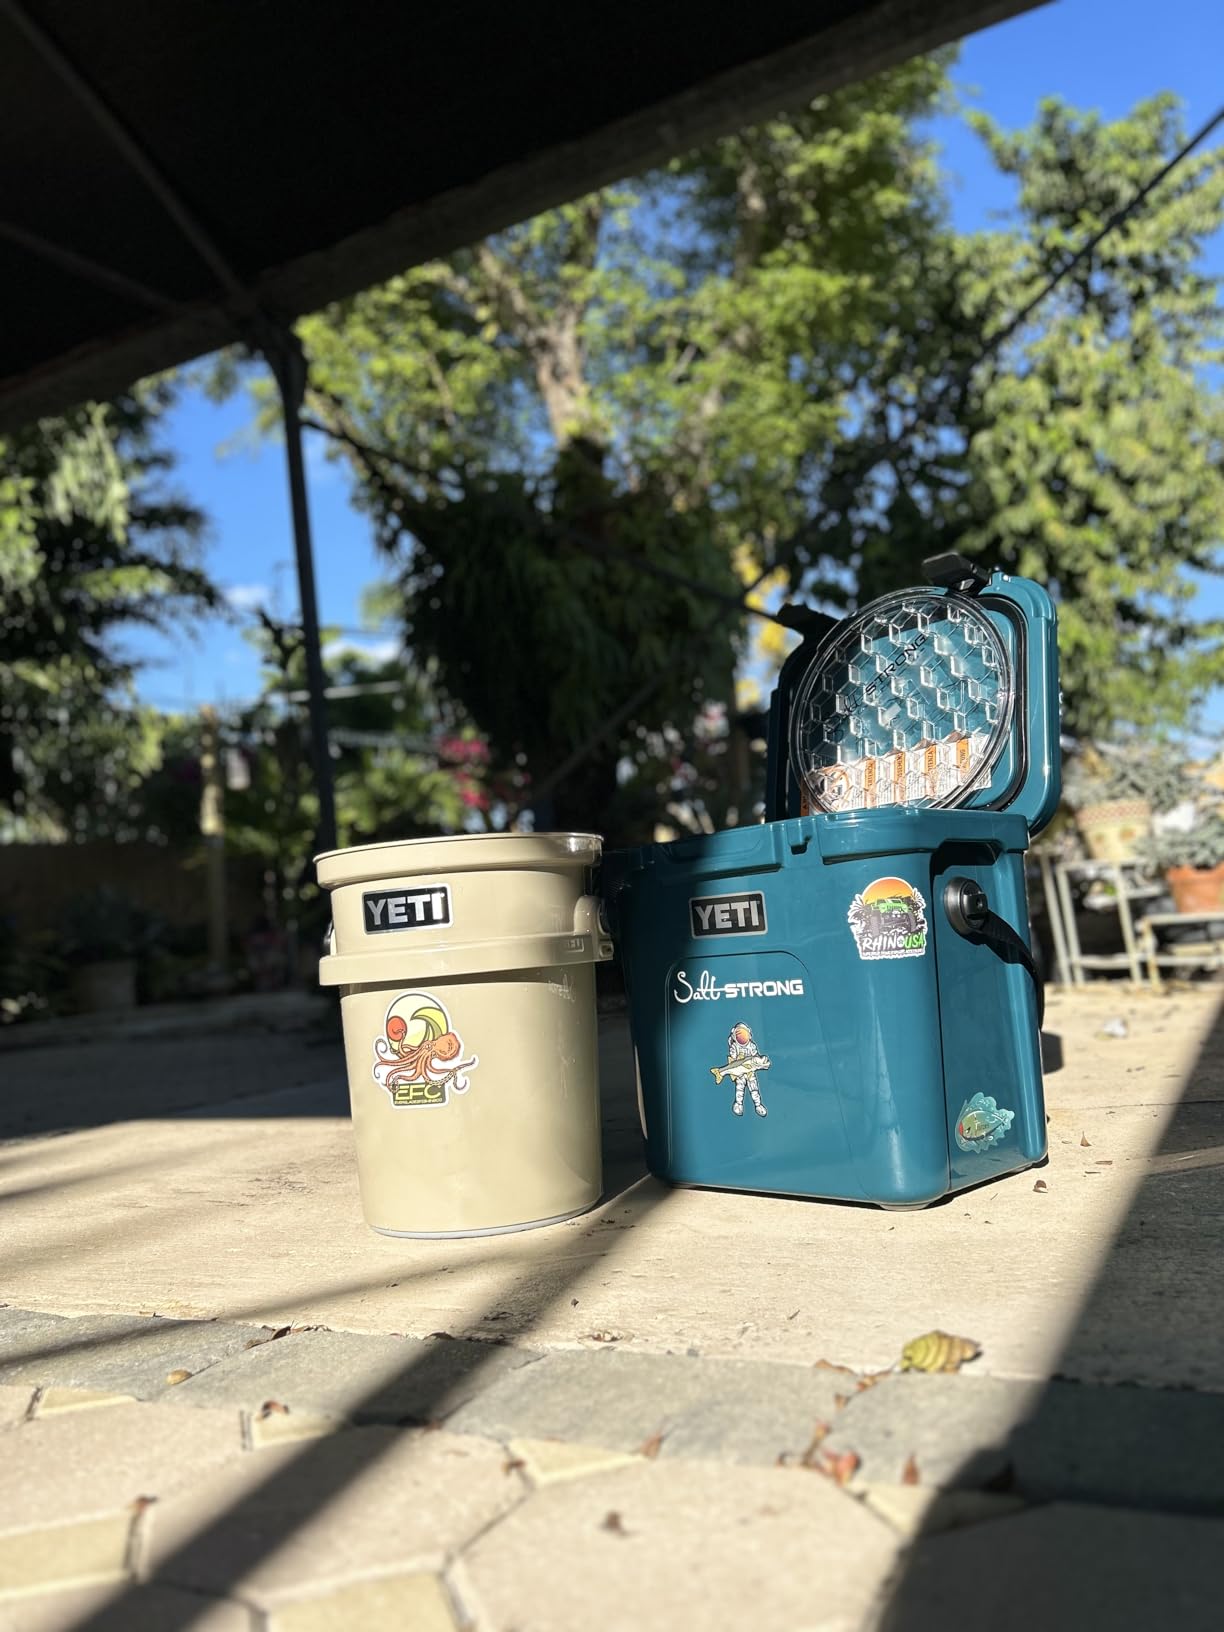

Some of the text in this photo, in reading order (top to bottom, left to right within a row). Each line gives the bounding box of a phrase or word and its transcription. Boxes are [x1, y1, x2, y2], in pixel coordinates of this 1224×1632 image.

[866, 634, 928, 695] STRONG
[366, 892, 445, 926] YETI
[694, 900, 760, 930] YETI
[862, 931, 926, 952] RHINO USA
[673, 970, 804, 1004] Salt STRONG
[395, 1084, 442, 1100] EFC
